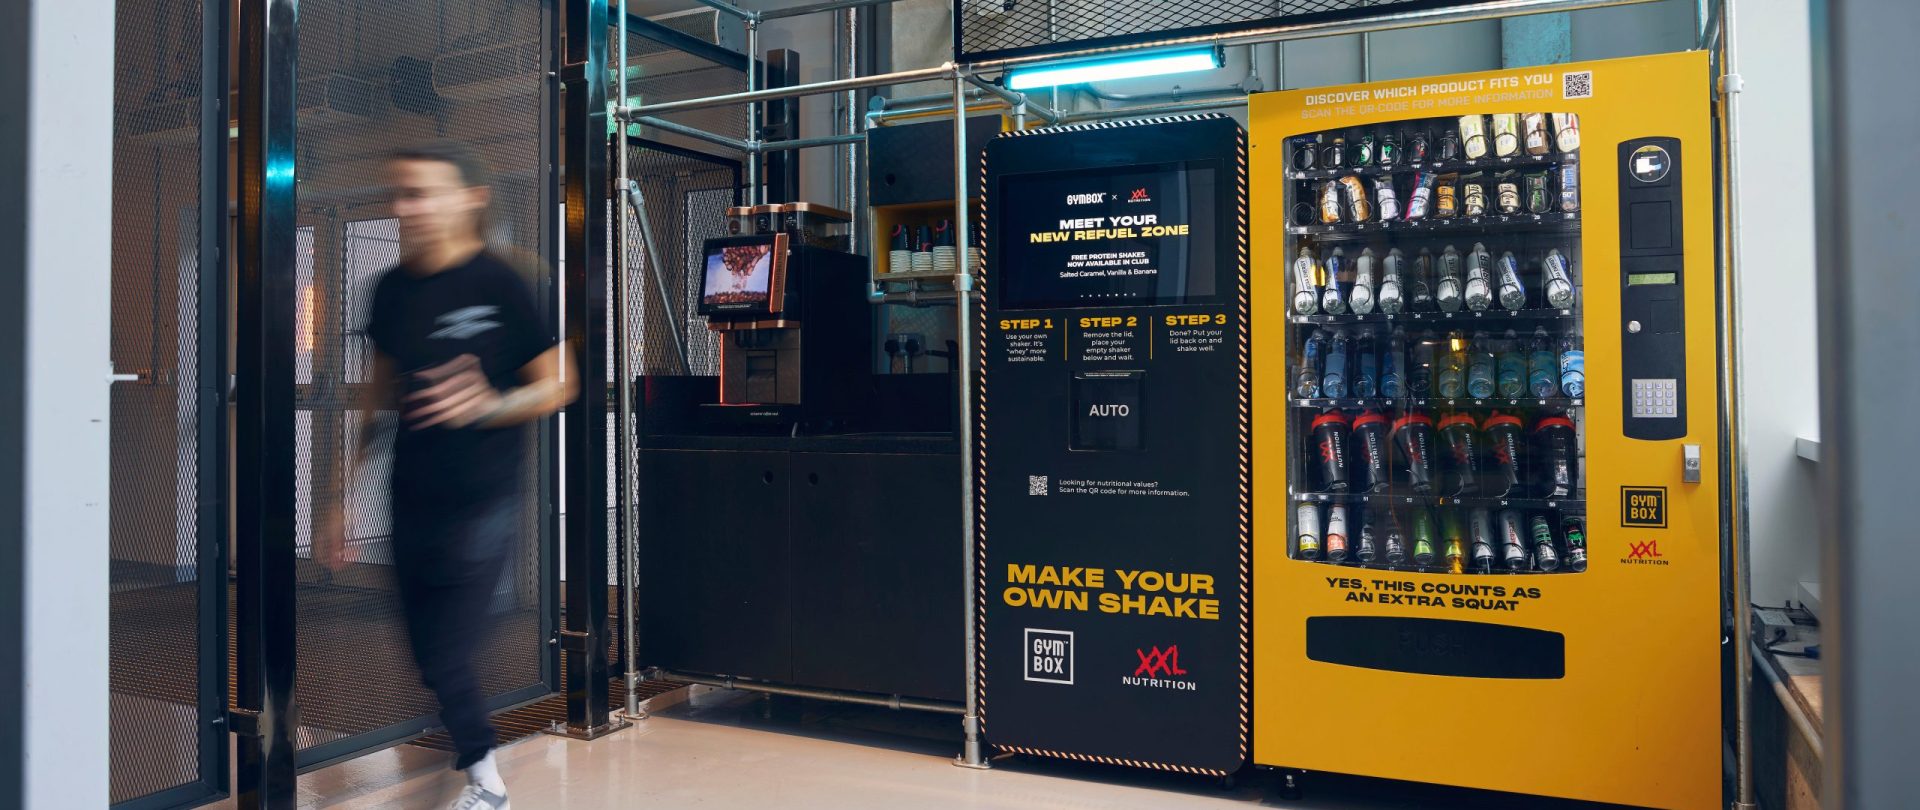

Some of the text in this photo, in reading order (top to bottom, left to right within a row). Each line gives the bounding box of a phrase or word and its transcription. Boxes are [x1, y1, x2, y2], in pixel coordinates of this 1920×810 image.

[1306, 72, 1553, 106] DISCOVER WHICH PRODUCT FITS YOU
[1302, 108, 1331, 119] SCAN
[1335, 106, 1356, 116] THE
[1412, 99, 1434, 109] FOR
[1438, 96, 1470, 107] MORE
[1474, 89, 1553, 104] INFORMATION
[1132, 187, 1148, 199] XXL
[1060, 215, 1157, 230] MEET YOUR
[1030, 224, 1189, 243] NEW REFUEL ZONE
[1080, 270, 1106, 278] Caramel,
[1000, 319, 1053, 330] STEP 1
[1080, 316, 1137, 328] STEP 2
[1166, 314, 1226, 326] STEP 3
[1089, 404, 1130, 417] AUTO
[1334, 432, 1344, 468] NUTRITION
[1370, 432, 1380, 469] NUTRITION
[1419, 432, 1428, 469] NUTRITION
[1508, 433, 1519, 471] NUTRITION
[1631, 508, 1657, 520] BOX
[1628, 540, 1662, 559] XXL
[1008, 564, 1215, 595] MAKE YOUR
[1326, 577, 1541, 599] YES, THIS COUNTS AS
[1003, 587, 1220, 620] OWN SHAKE
[1346, 592, 1519, 612] AN EXTRA SQUAT
[1034, 656, 1064, 674] BOX
[1135, 644, 1187, 678] XXL
[1122, 676, 1196, 691] NUTRITION
